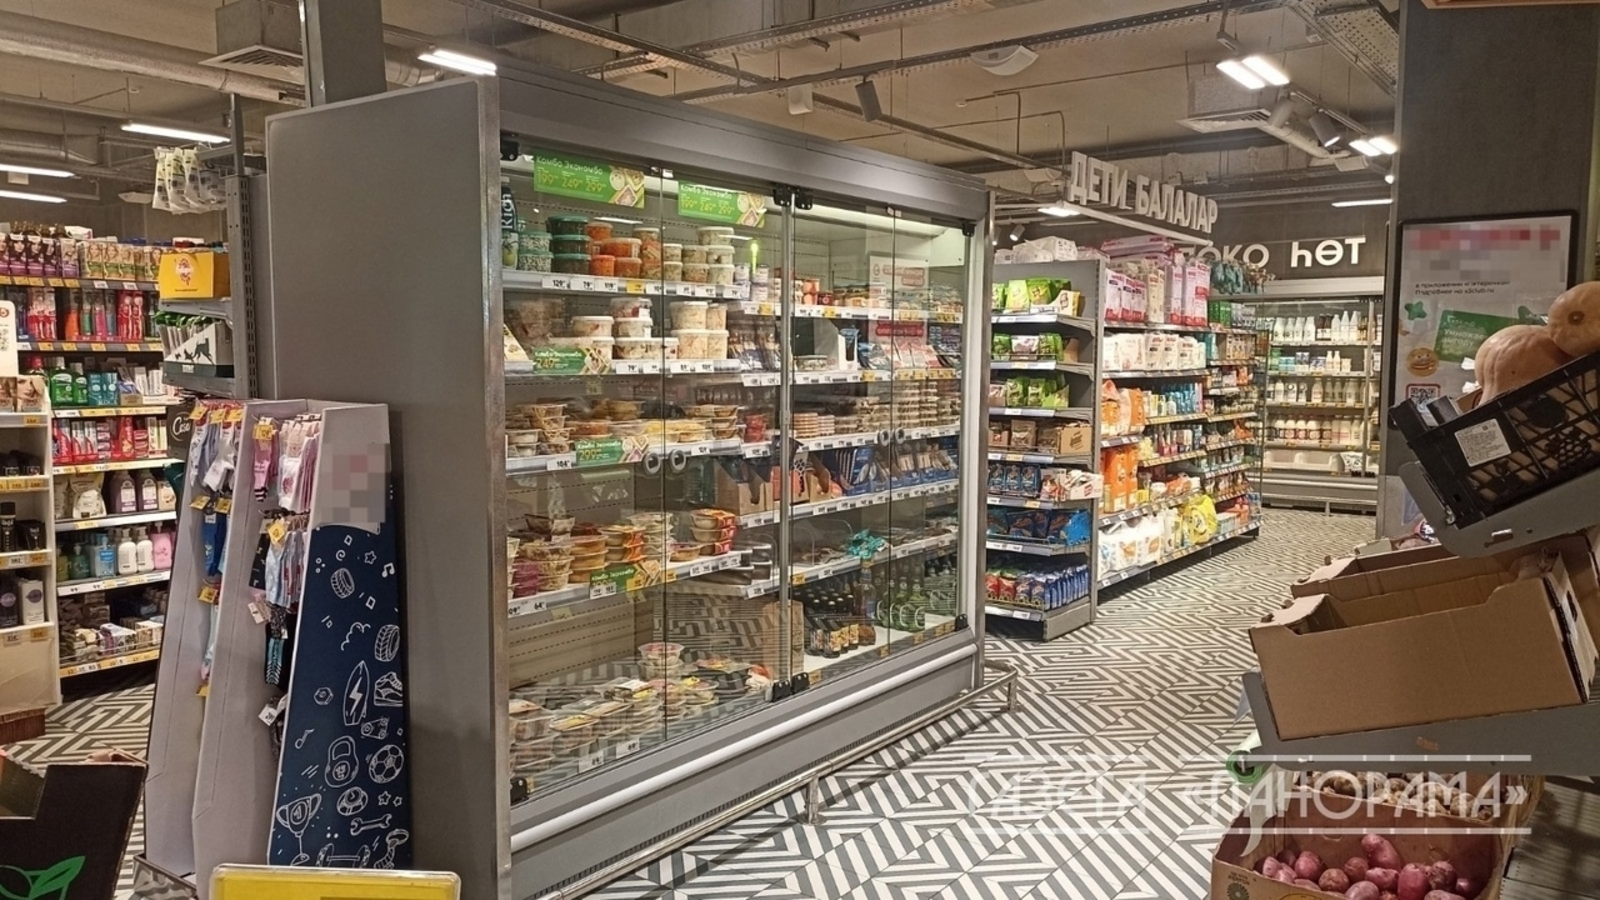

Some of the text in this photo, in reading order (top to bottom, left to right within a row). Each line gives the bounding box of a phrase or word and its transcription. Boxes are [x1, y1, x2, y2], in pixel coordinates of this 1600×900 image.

[536, 156, 563, 167] Комбо
[564, 161, 603, 175] Экономбо
[1066, 150, 1219, 234] ДЕТИ БАЛАЛАР
